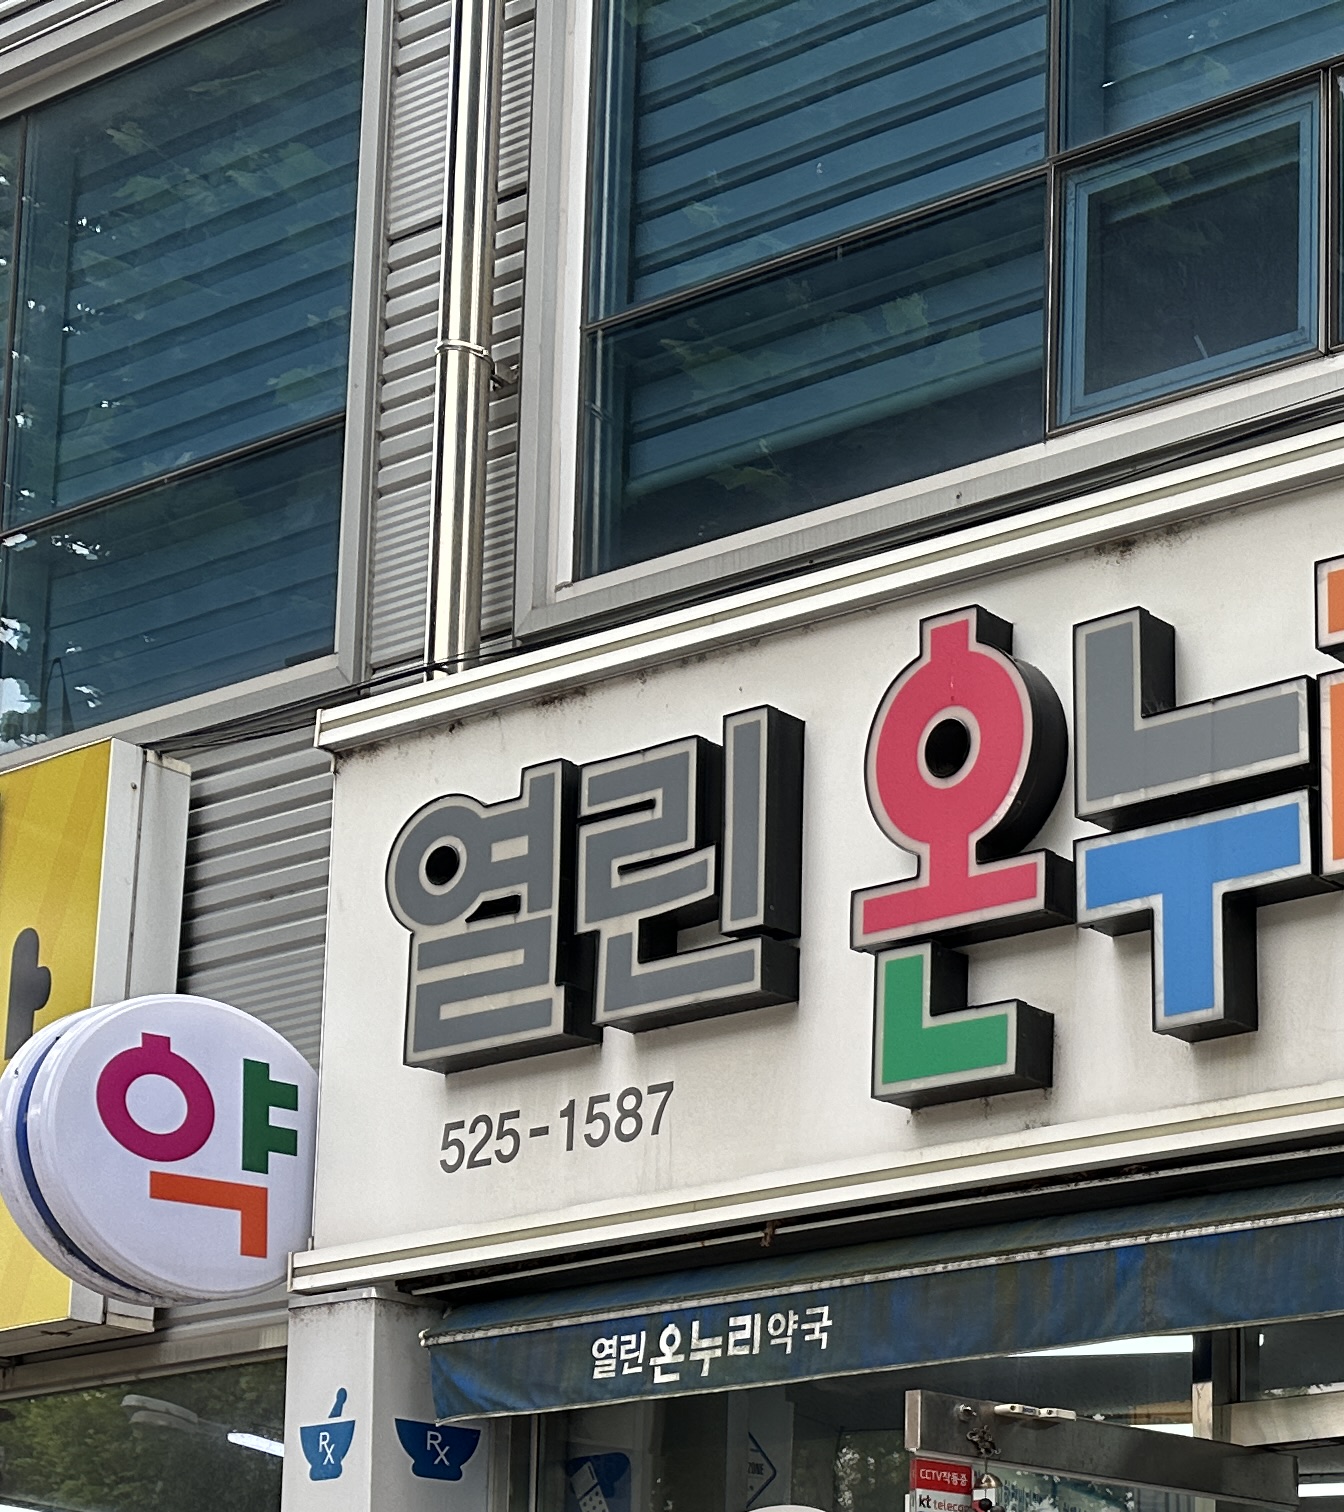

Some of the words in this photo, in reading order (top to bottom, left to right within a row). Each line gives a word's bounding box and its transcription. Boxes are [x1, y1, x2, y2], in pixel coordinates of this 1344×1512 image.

[386, 705, 805, 1074] 열린
[96, 1032, 299, 1259] 약
[438, 1081, 675, 1175] 525-1587
[590, 1330, 647, 1381] 열린
[650, 1314, 764, 1385] 온누리
[768, 1304, 834, 1354] 약국
[918, 1494, 932, 1509] kt
